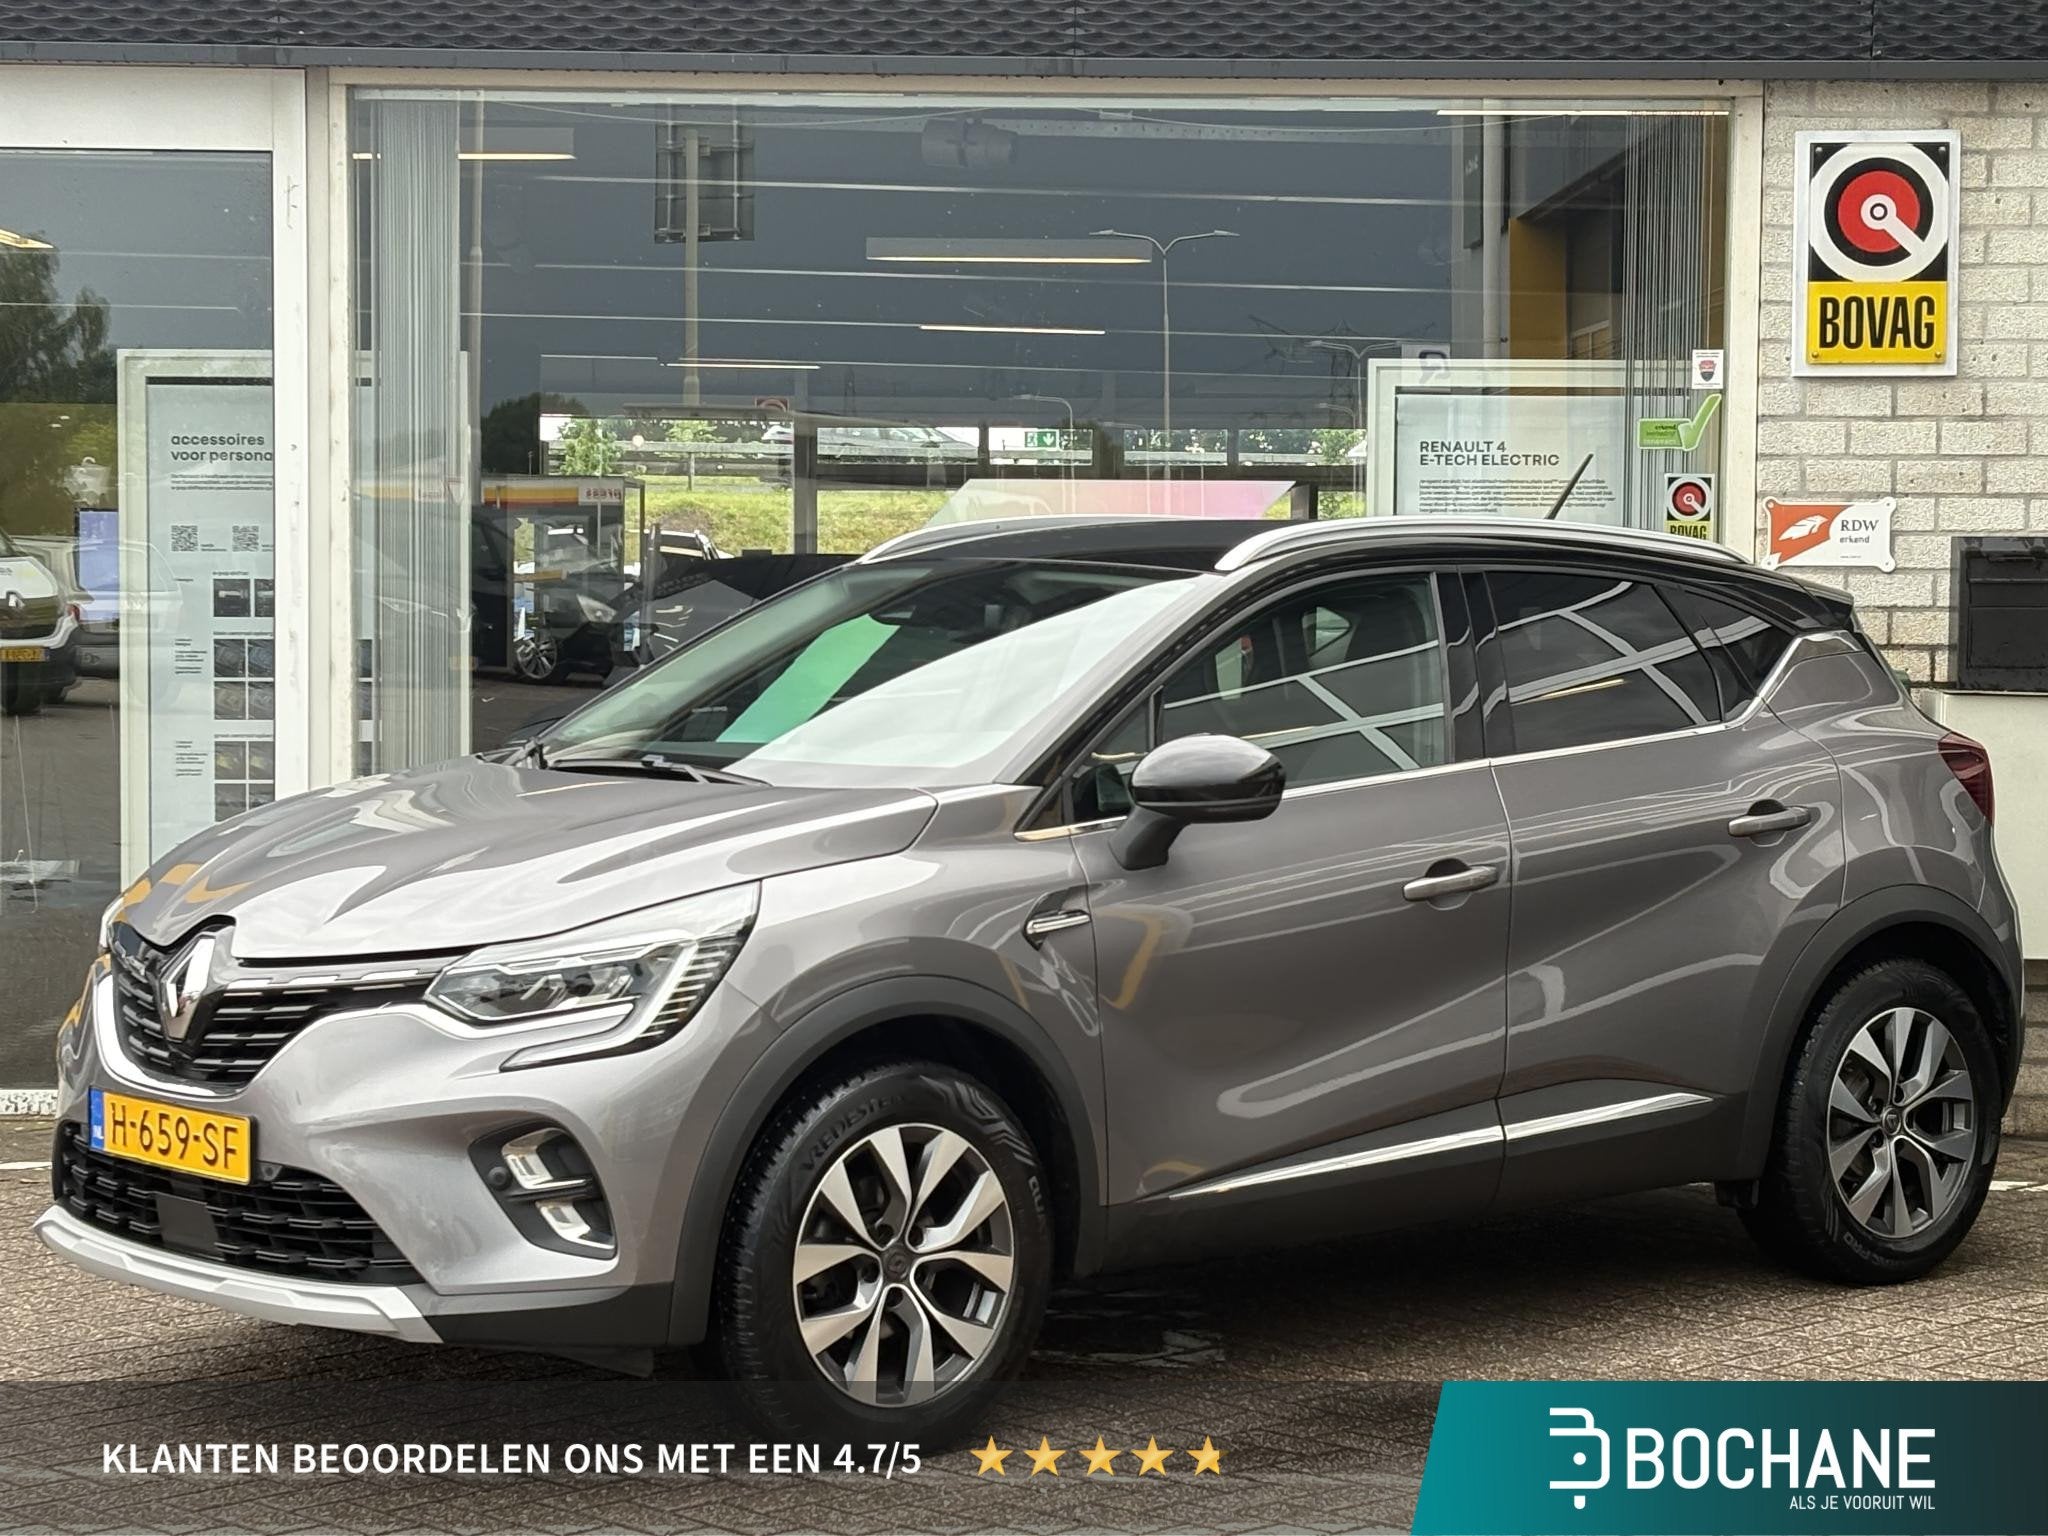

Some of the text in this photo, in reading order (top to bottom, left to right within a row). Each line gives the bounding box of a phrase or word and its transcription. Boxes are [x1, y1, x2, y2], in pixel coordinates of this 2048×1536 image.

[1818, 295, 1936, 350] BOVAG
[170, 433, 265, 446] accessoires
[1419, 441, 1507, 453] RENAULT 4
[170, 451, 207, 461] voor
[1419, 454, 1560, 466] E-TECH ELECTRIC
[1840, 519, 1880, 531] RDW
[1670, 524, 1707, 540] BOVAG
[1839, 535, 1870, 544] erkend
[110, 1102, 238, 1169] H-659-SF
